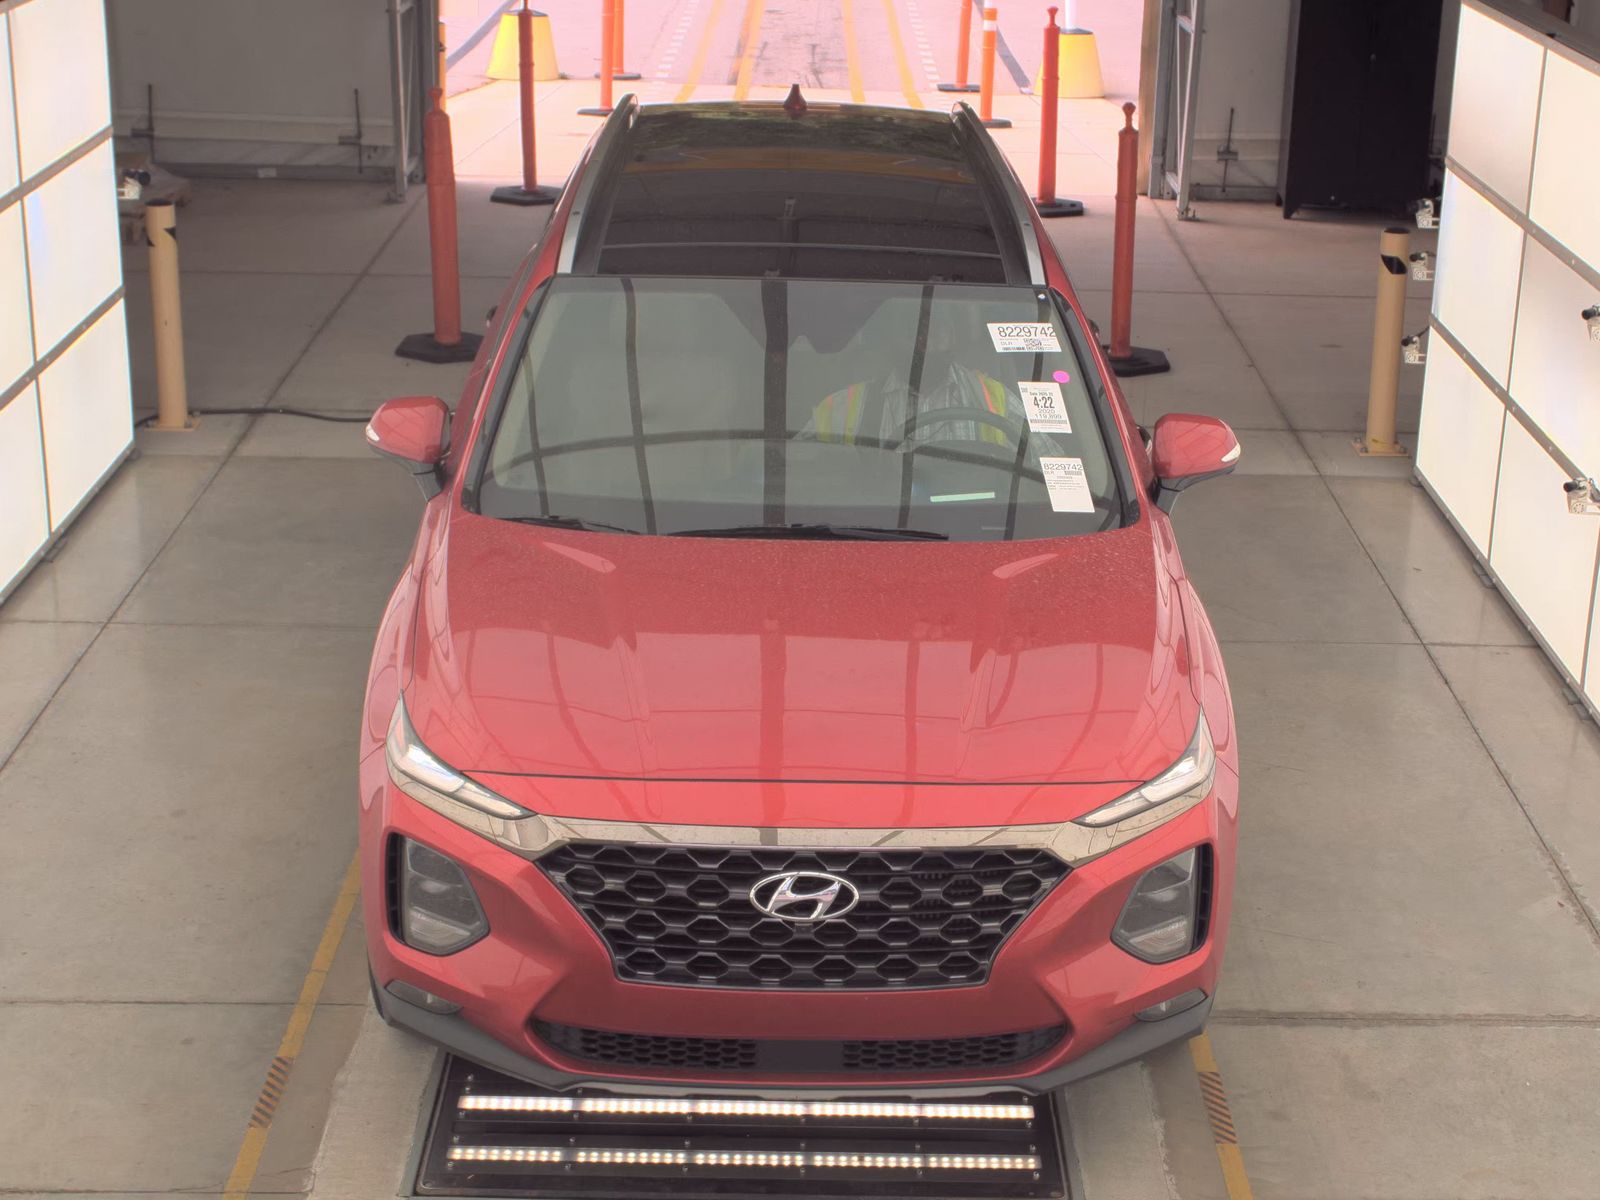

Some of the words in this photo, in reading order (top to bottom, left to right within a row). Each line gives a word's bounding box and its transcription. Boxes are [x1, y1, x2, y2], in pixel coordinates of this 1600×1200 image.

[997, 326, 1056, 338] 8229742
[1033, 396, 1055, 409] 4:22
[1043, 463, 1083, 471] 8229742
